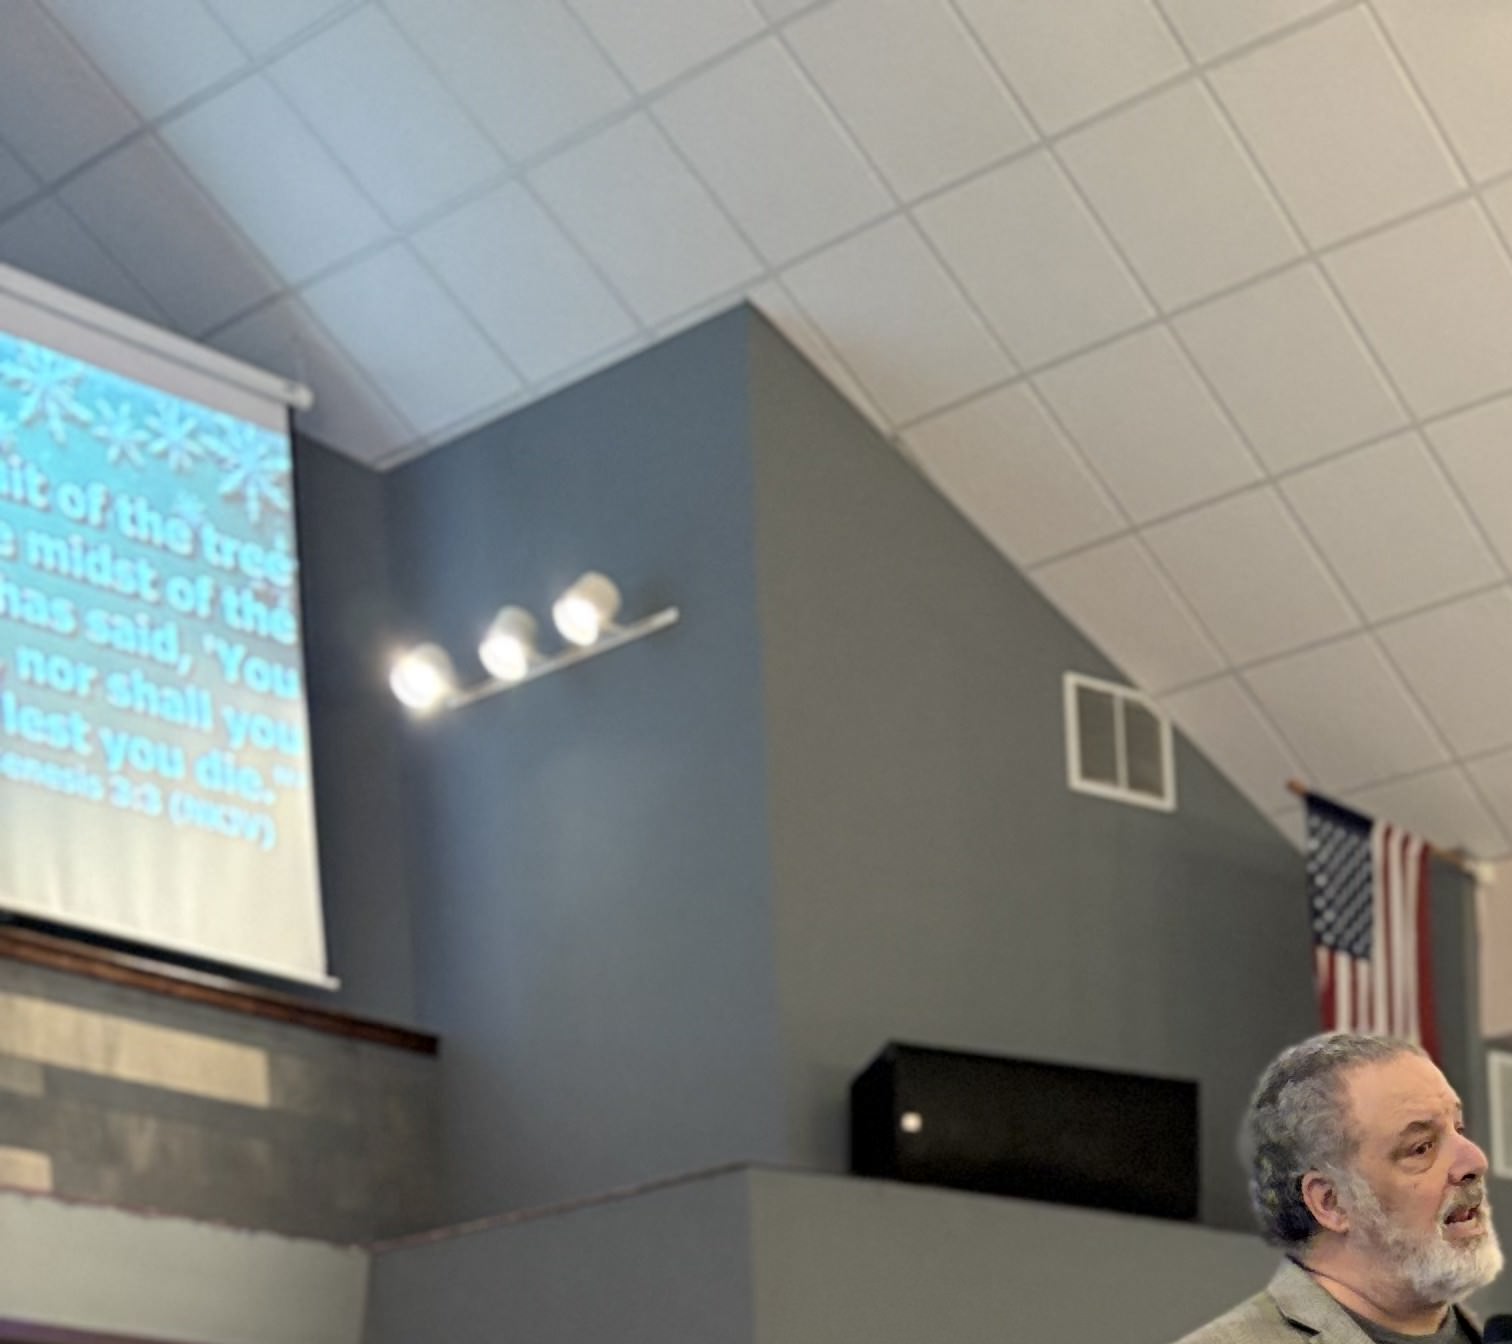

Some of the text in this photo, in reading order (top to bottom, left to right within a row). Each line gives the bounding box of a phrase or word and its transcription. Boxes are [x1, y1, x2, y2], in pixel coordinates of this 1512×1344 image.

[0, 453, 297, 588] it of the tree
[26, 529, 160, 602] midst
[165, 574, 214, 619] of
[221, 585, 297, 645] the
[86, 606, 192, 677] said,
[3, 690, 92, 757] lest
[98, 726, 185, 780] you
[16, 645, 305, 758] nor shall you
